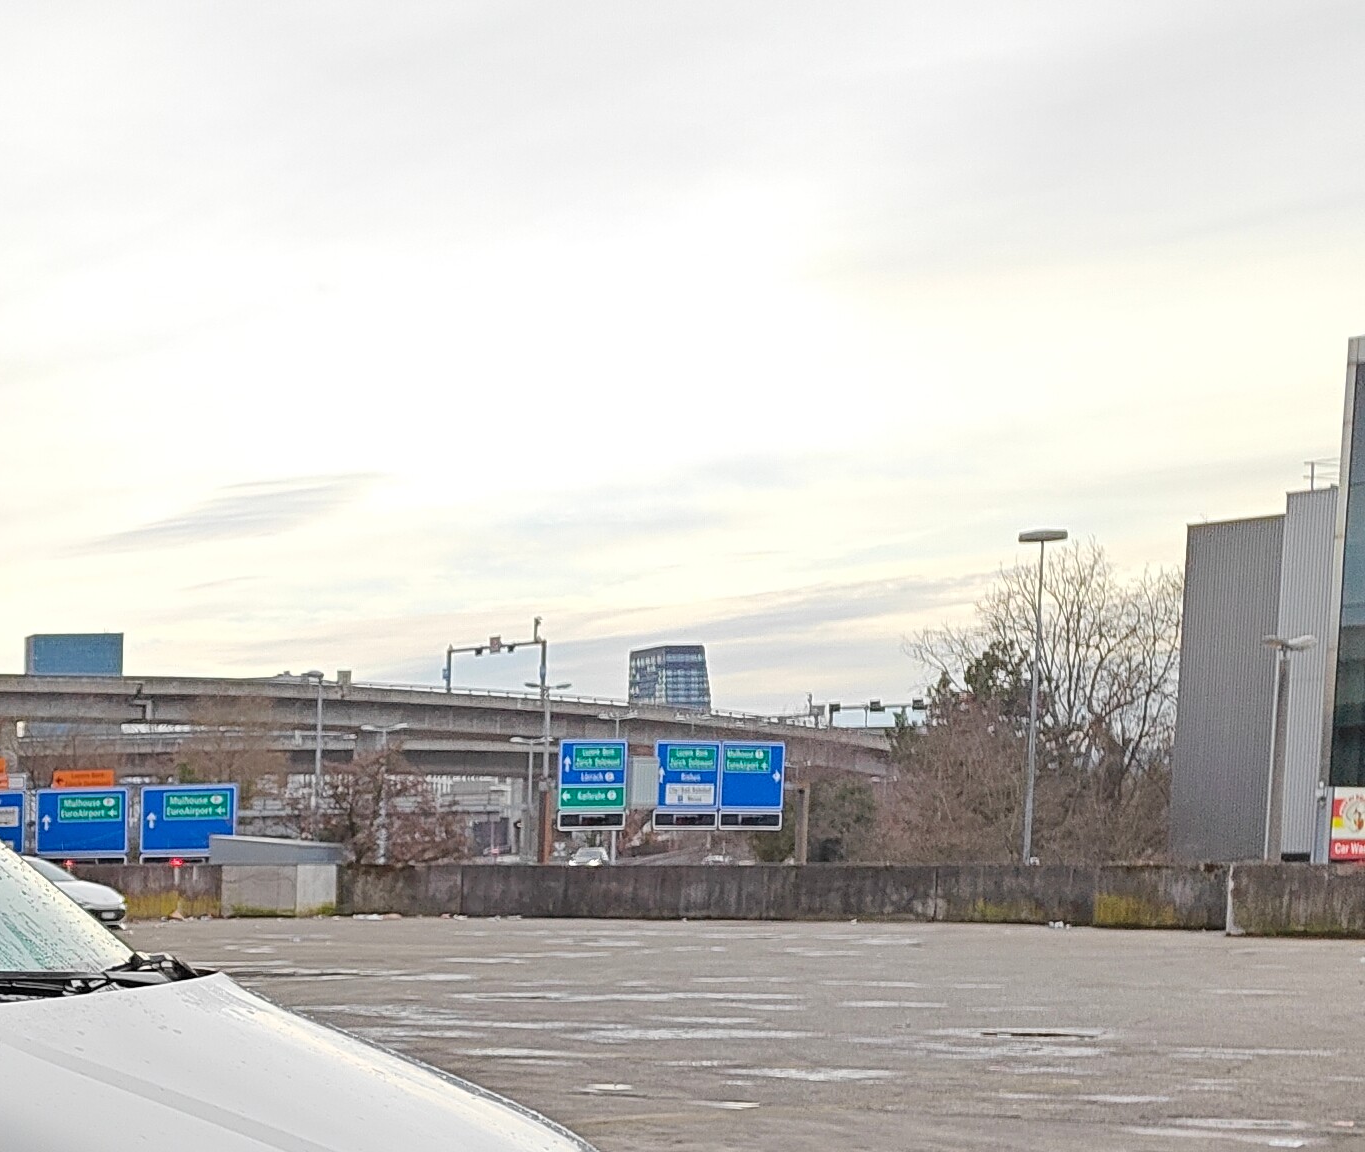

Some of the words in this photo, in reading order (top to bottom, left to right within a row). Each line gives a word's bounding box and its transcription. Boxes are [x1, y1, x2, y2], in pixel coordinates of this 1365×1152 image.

[63, 799, 101, 808] Mulhouse
[169, 796, 208, 805] Mulhouse
[60, 809, 105, 819] EuroAirport
[166, 806, 212, 817] EuroAirport
[1334, 842, 1350, 855] Car
